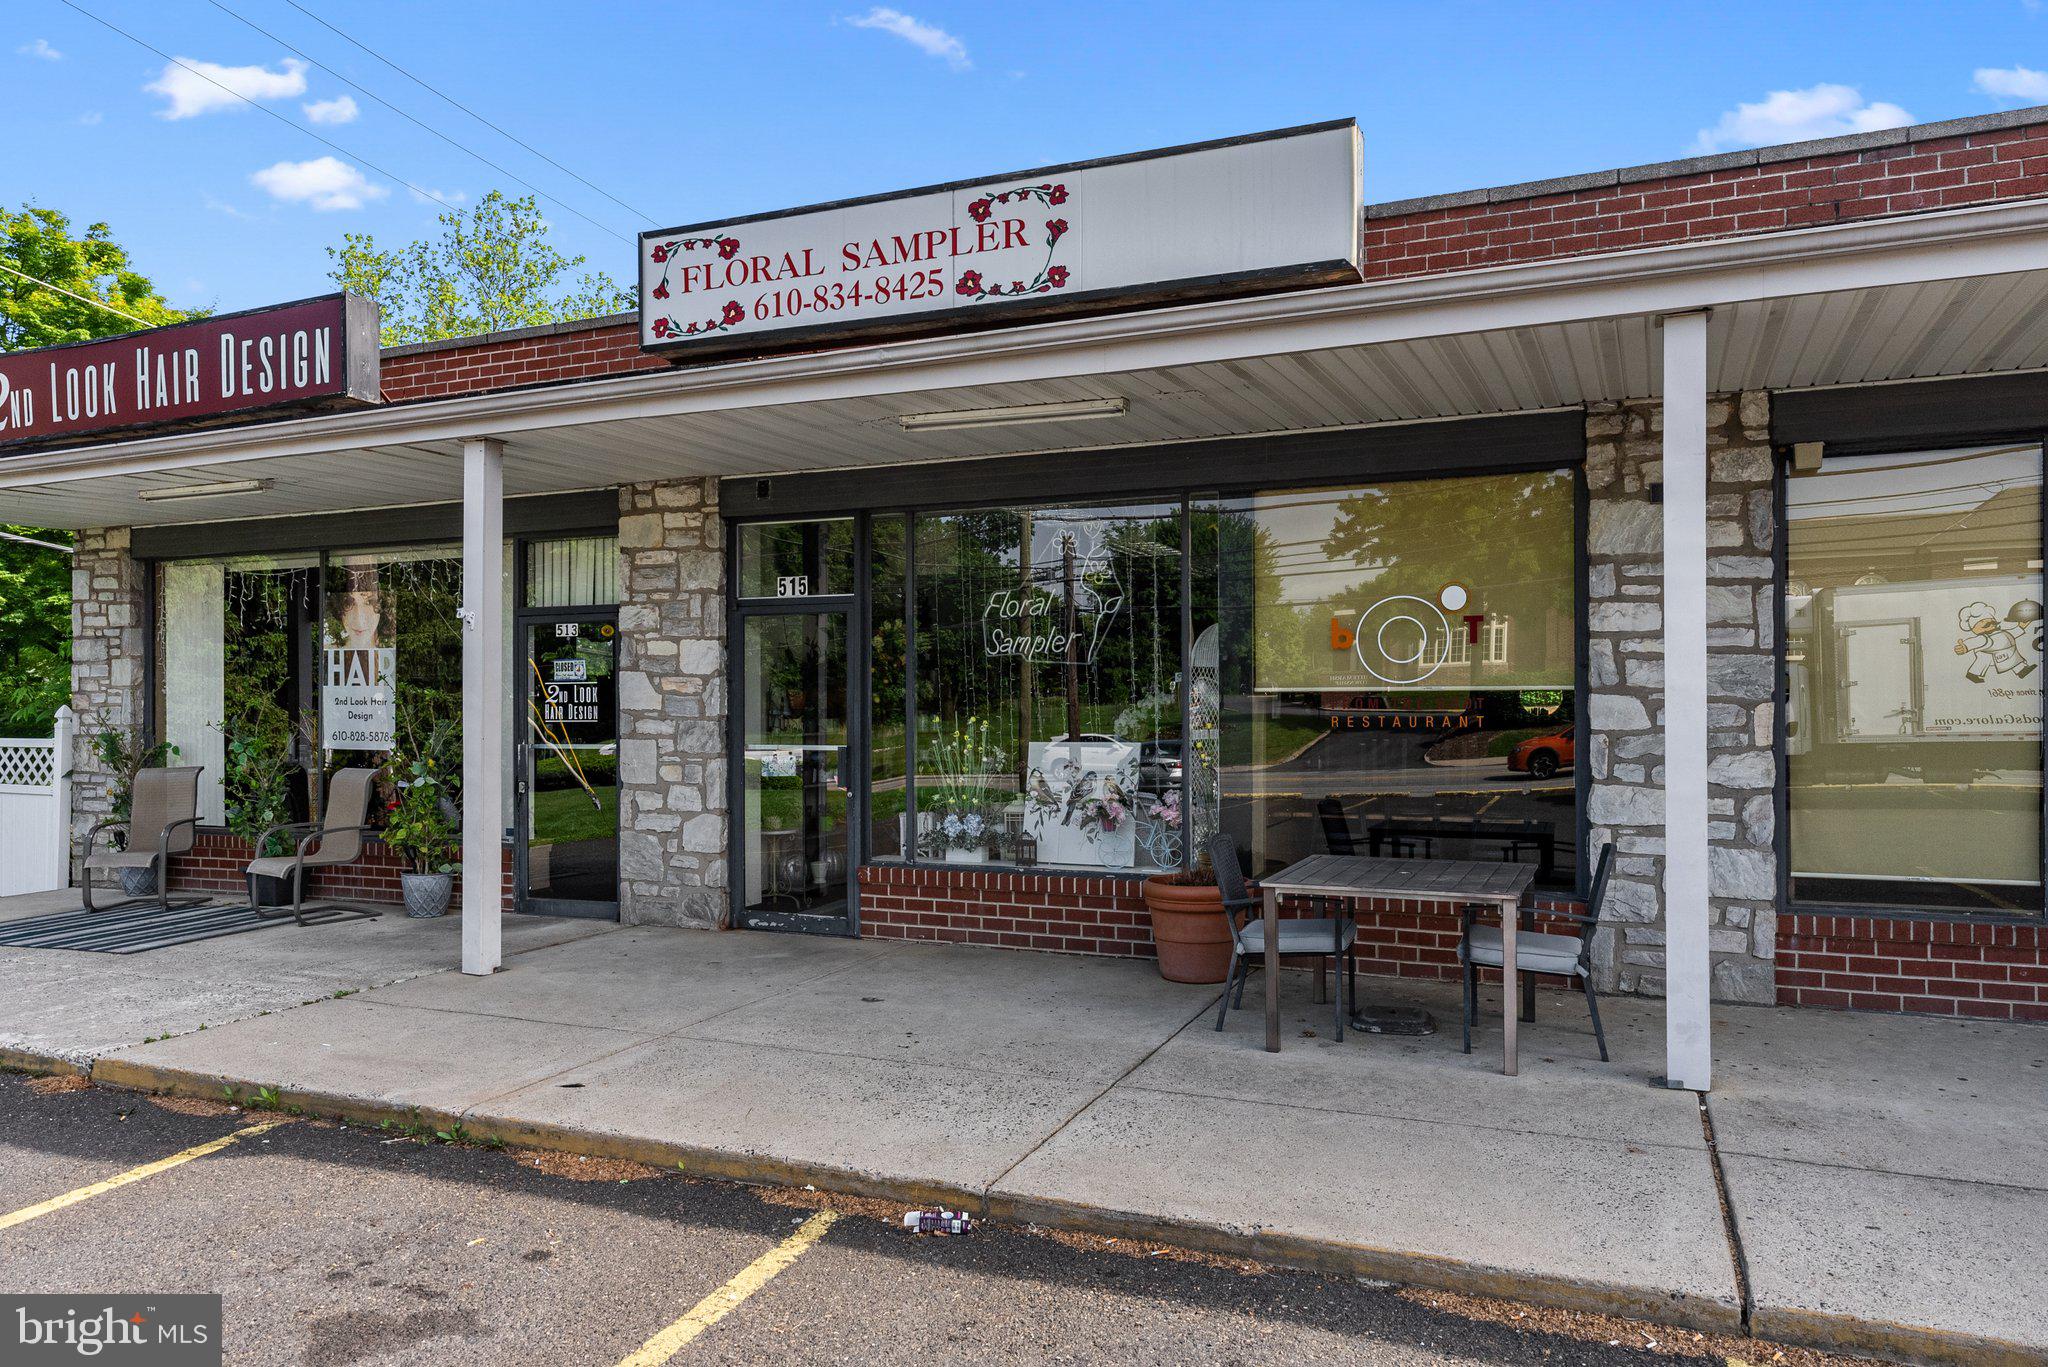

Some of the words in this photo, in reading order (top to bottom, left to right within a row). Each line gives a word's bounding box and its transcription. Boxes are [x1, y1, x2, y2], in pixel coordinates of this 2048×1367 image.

[681, 249, 826, 294] FLORAL
[842, 218, 1030, 272] SAMPLER
[753, 268, 944, 321] 610-834-8425
[50, 361, 117, 423] LOOK
[136, 346, 200, 411] HAIR
[220, 326, 331, 399] DESIGN
[778, 577, 807, 596] 515
[984, 588, 1056, 618] Floral
[556, 625, 578, 636] 513
[986, 626, 1083, 661] Sampler
[327, 650, 395, 686] HAIR
[334, 697, 347, 706] 2nd
[350, 697, 368, 706] Look
[371, 697, 388, 706] Hair
[545, 685, 568, 703] 2ND
[574, 684, 598, 703] LOOK
[348, 710, 374, 721] Design
[568, 703, 599, 720] DESIGN
[1331, 715, 1485, 728] RESTAURANT
[332, 730, 389, 742] 610-828-5878
